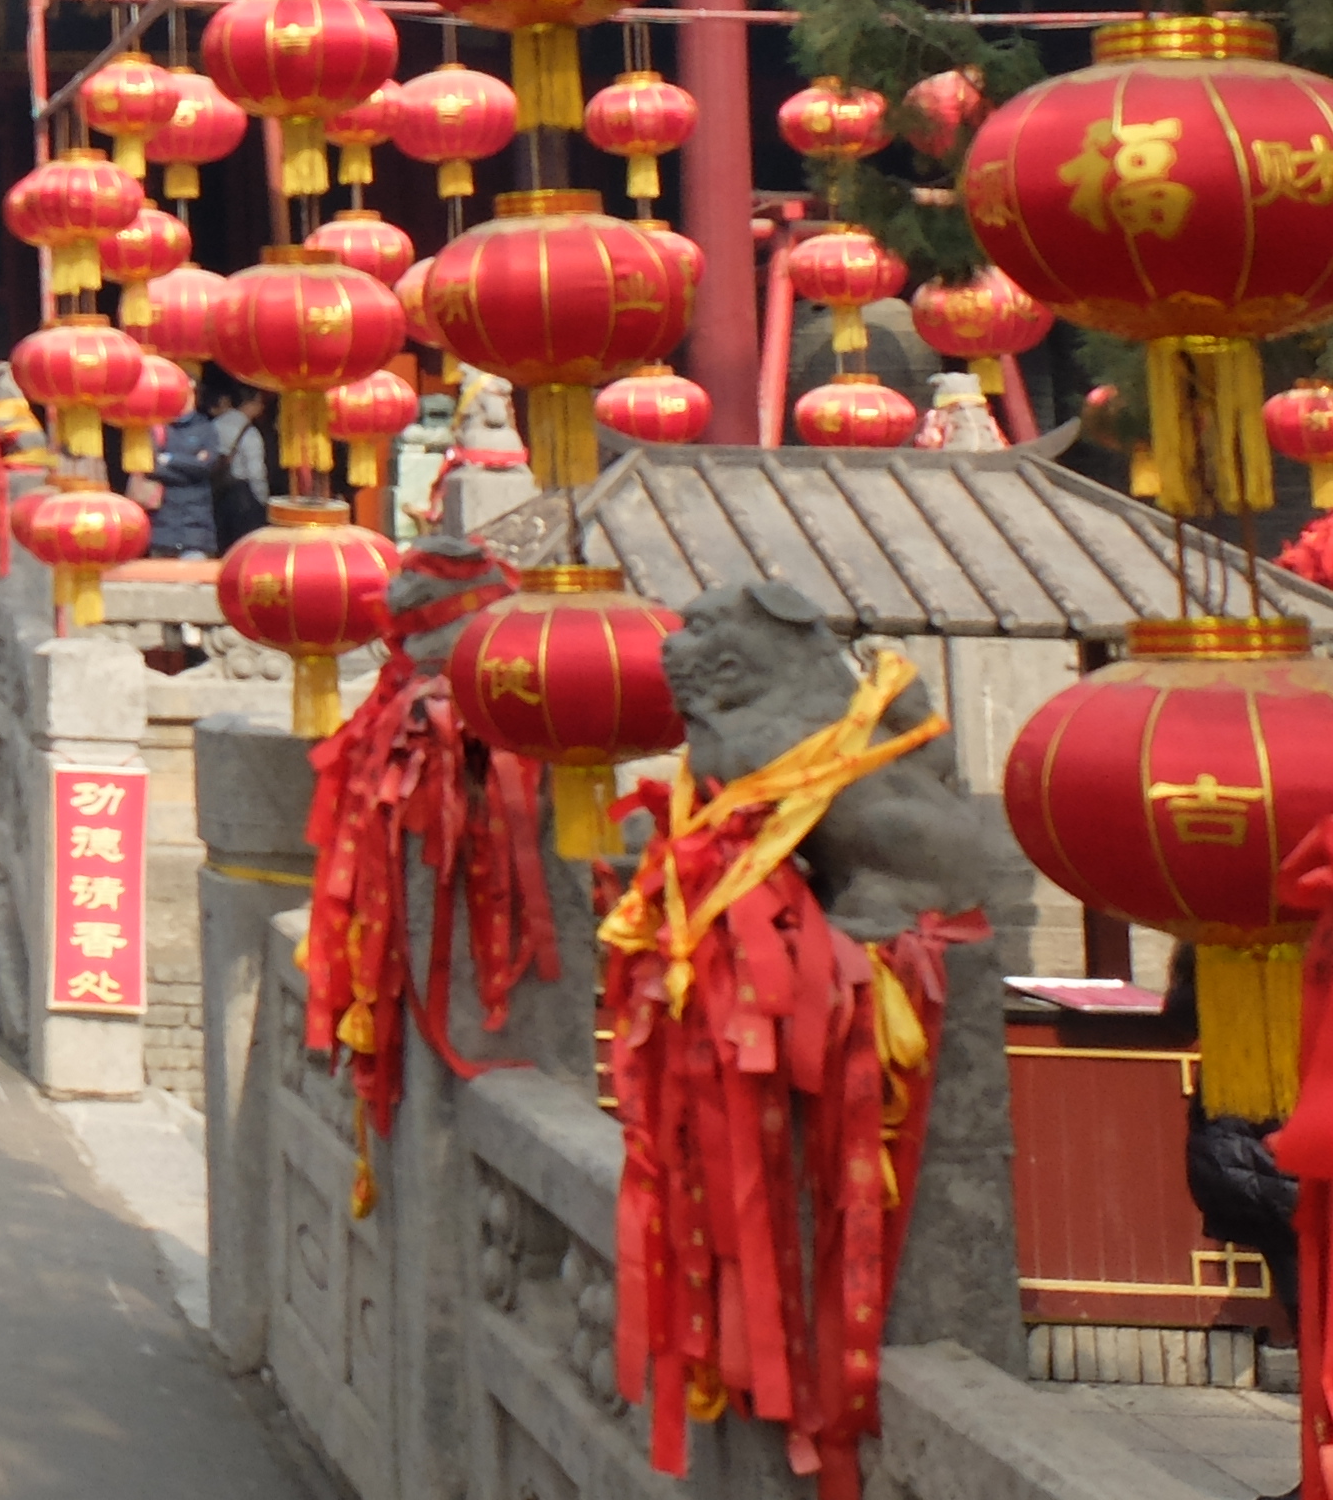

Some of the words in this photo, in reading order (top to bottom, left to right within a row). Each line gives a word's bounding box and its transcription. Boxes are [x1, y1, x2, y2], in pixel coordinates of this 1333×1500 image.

[1057, 116, 1195, 239] 福
[1149, 772, 1263, 846] 吉
[67, 782, 128, 1003] 功德请香处
